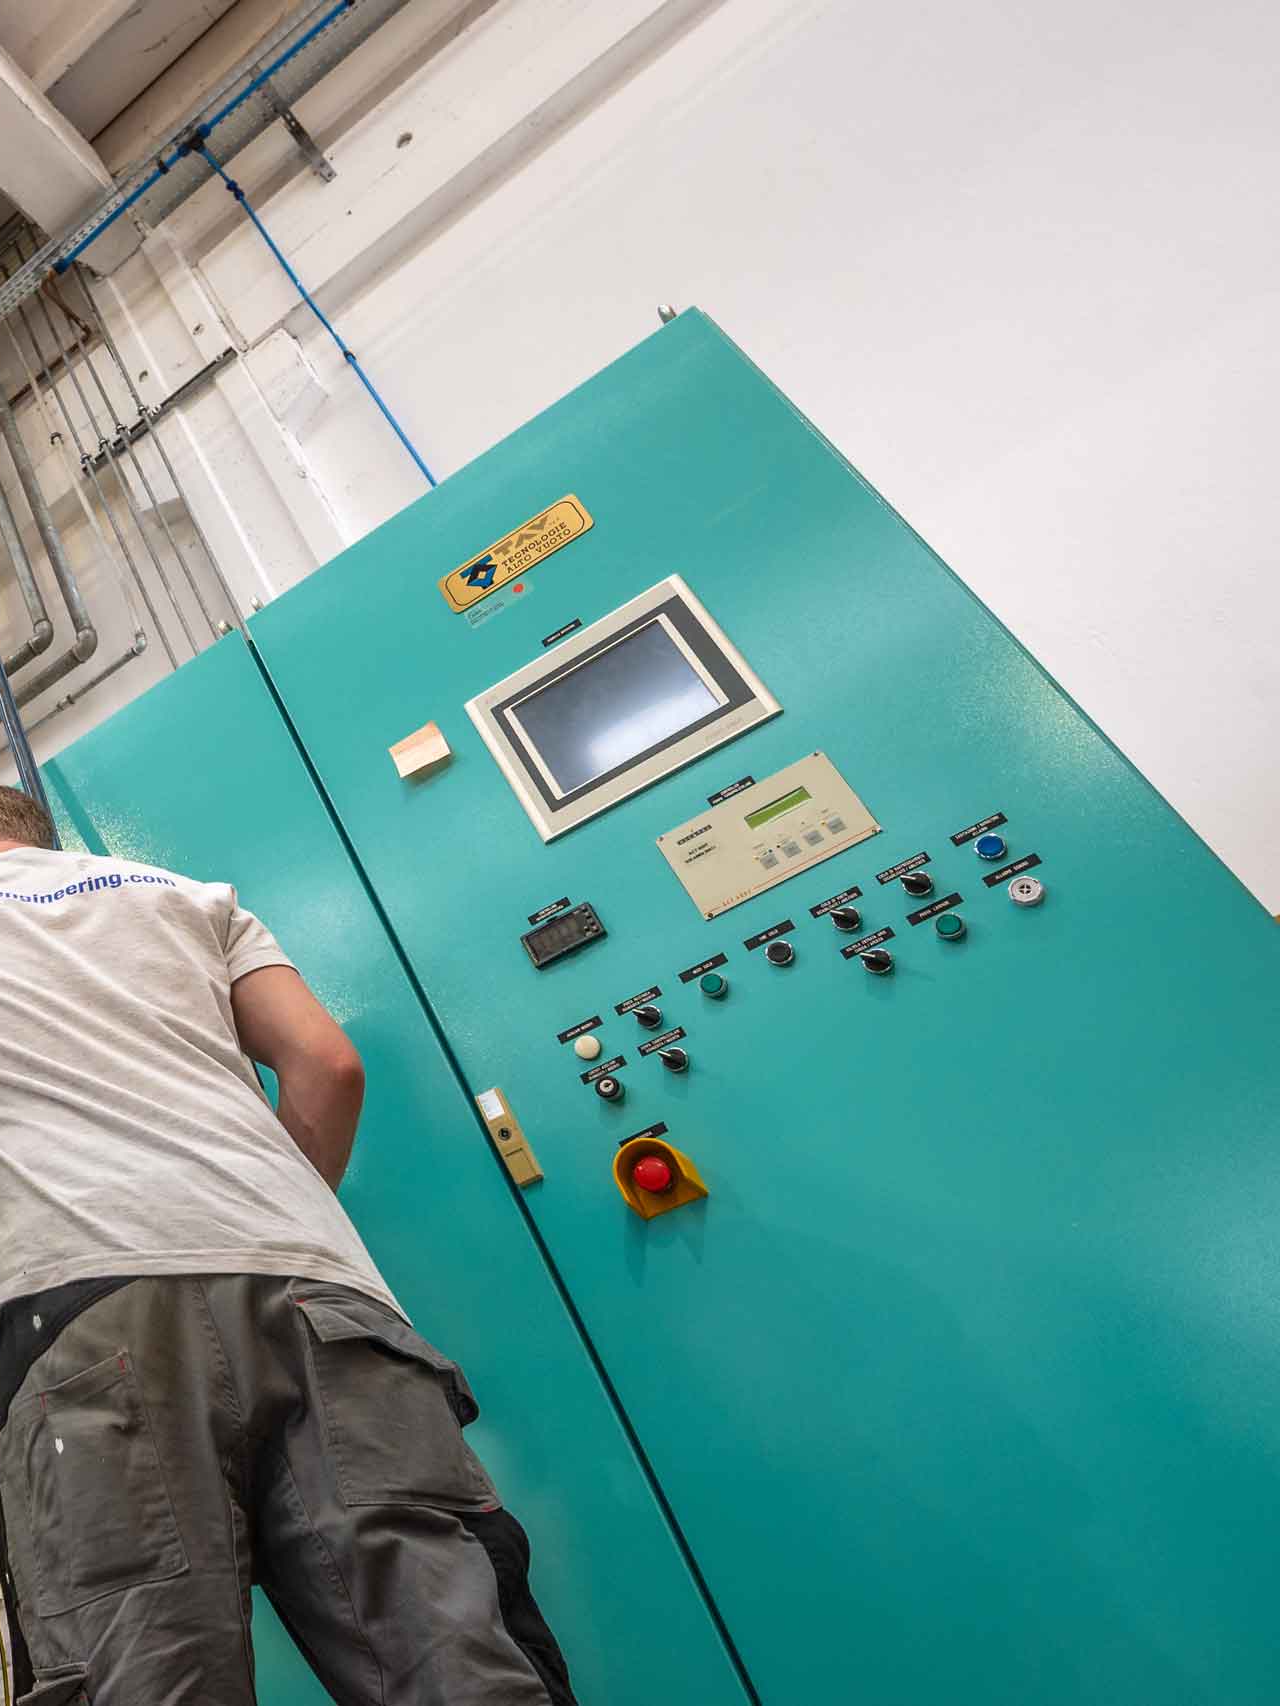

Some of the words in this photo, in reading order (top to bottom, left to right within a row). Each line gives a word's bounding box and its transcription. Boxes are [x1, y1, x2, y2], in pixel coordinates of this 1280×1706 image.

[493, 515, 549, 556] TAV
[501, 521, 567, 567] TECNOLOGIE
[506, 554, 532, 574] ALTO
[535, 528, 571, 553] VUOTO
